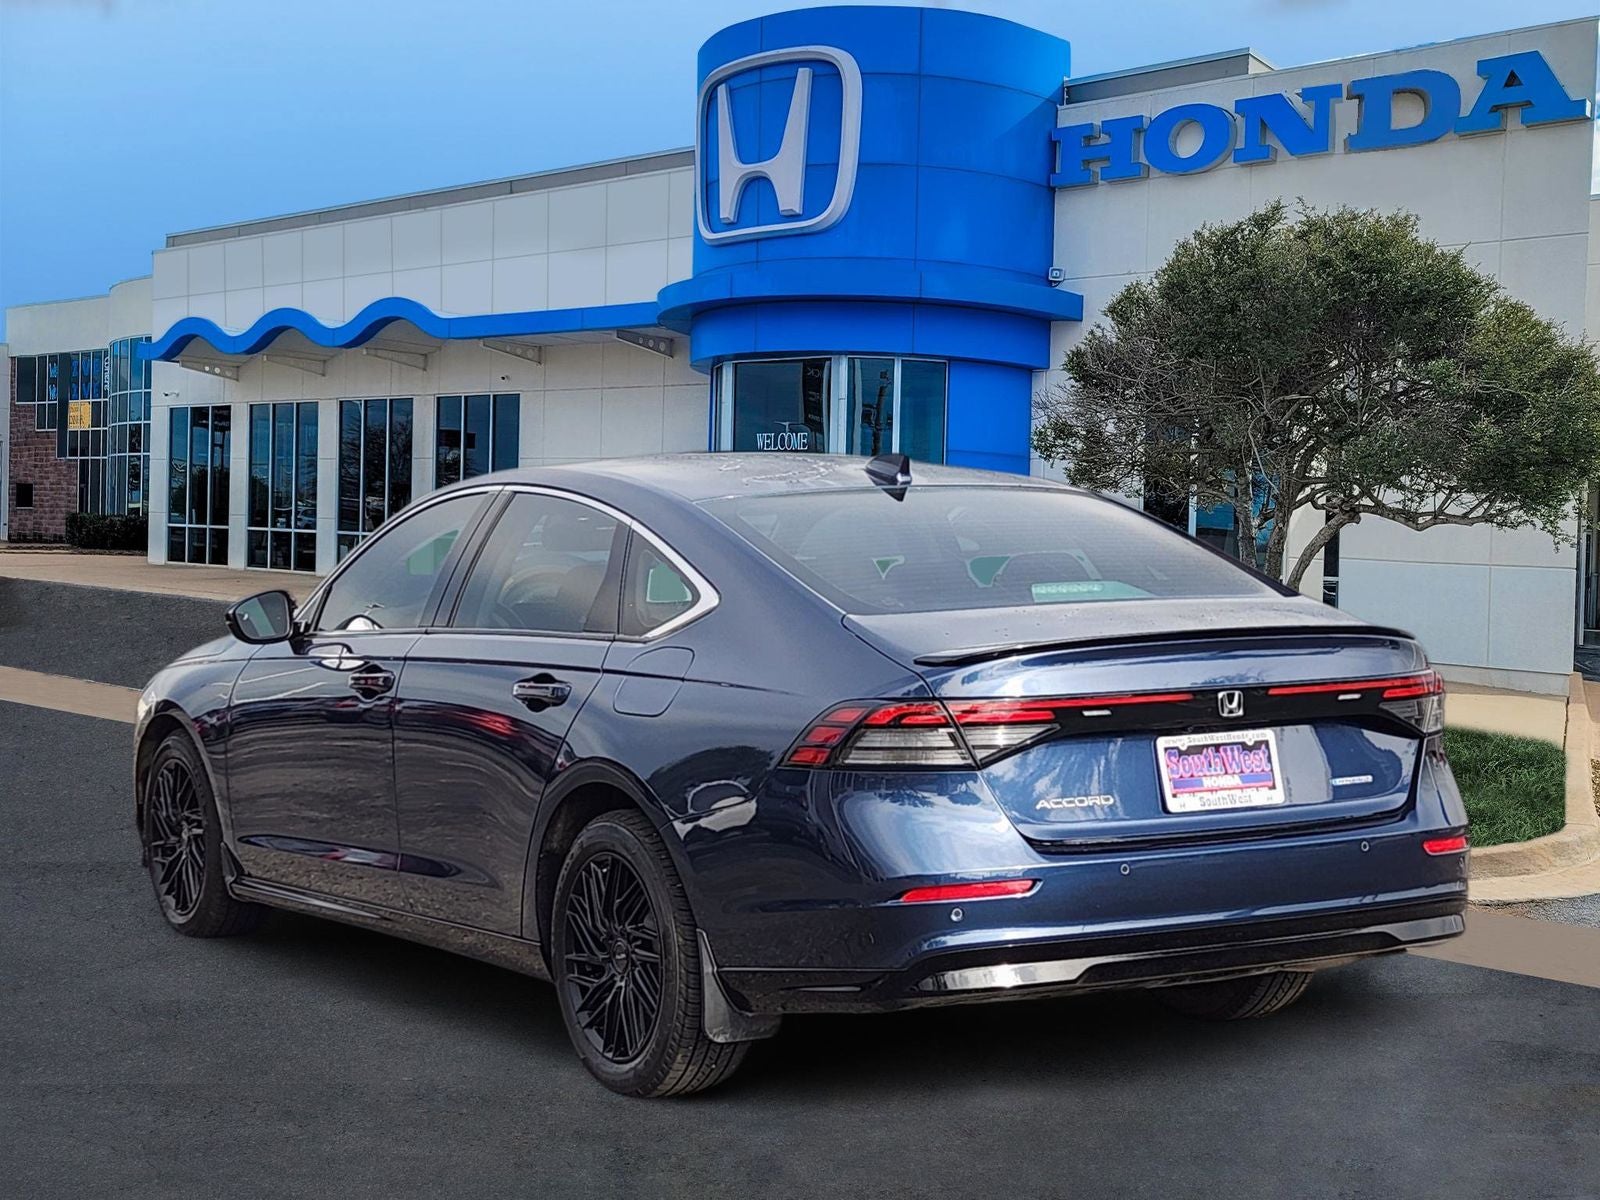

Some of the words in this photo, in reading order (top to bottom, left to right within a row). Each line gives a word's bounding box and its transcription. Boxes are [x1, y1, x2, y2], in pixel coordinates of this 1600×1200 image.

[1050, 50, 1591, 188] HONDA
[756, 432, 808, 451] WELCOME
[1035, 794, 1115, 810] ACCORD
